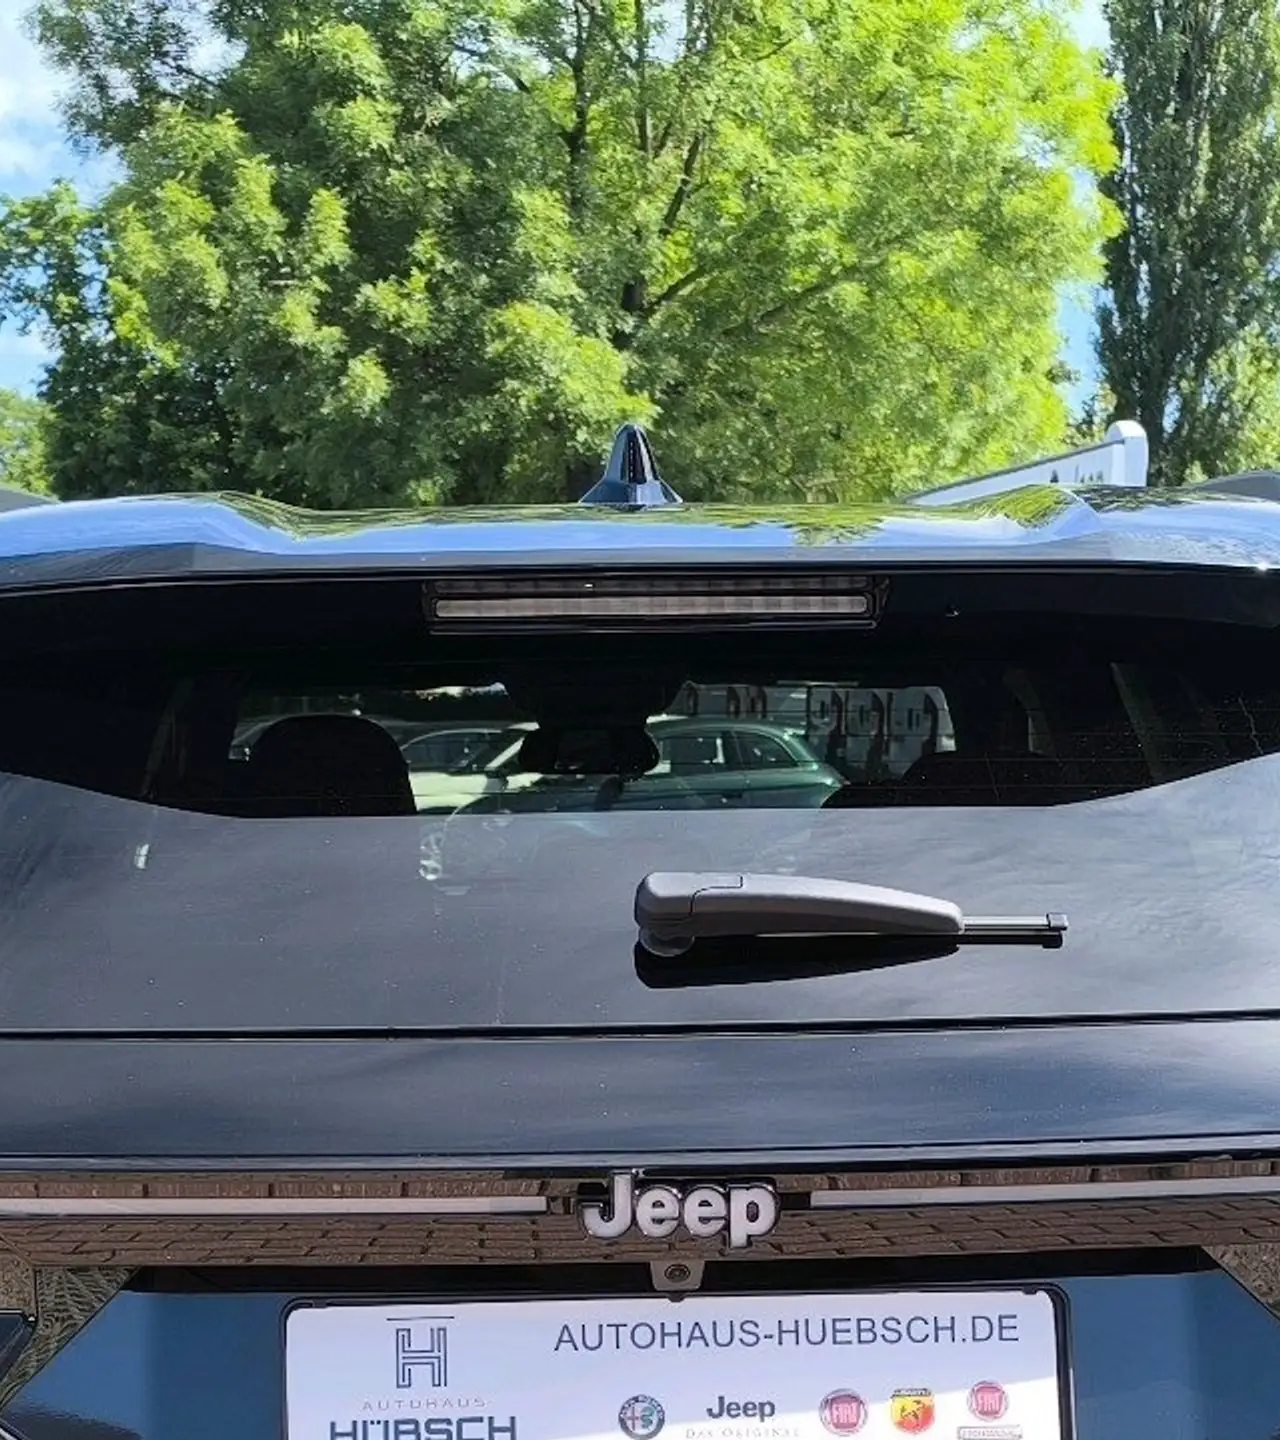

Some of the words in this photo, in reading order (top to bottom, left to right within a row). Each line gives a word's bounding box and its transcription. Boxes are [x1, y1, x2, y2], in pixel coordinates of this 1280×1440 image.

[581, 1168, 783, 1250] Jeep
[553, 1314, 1020, 1352] AUTOHAUS-HUEBSCH.DE
[705, 1395, 776, 1423] Jeep
